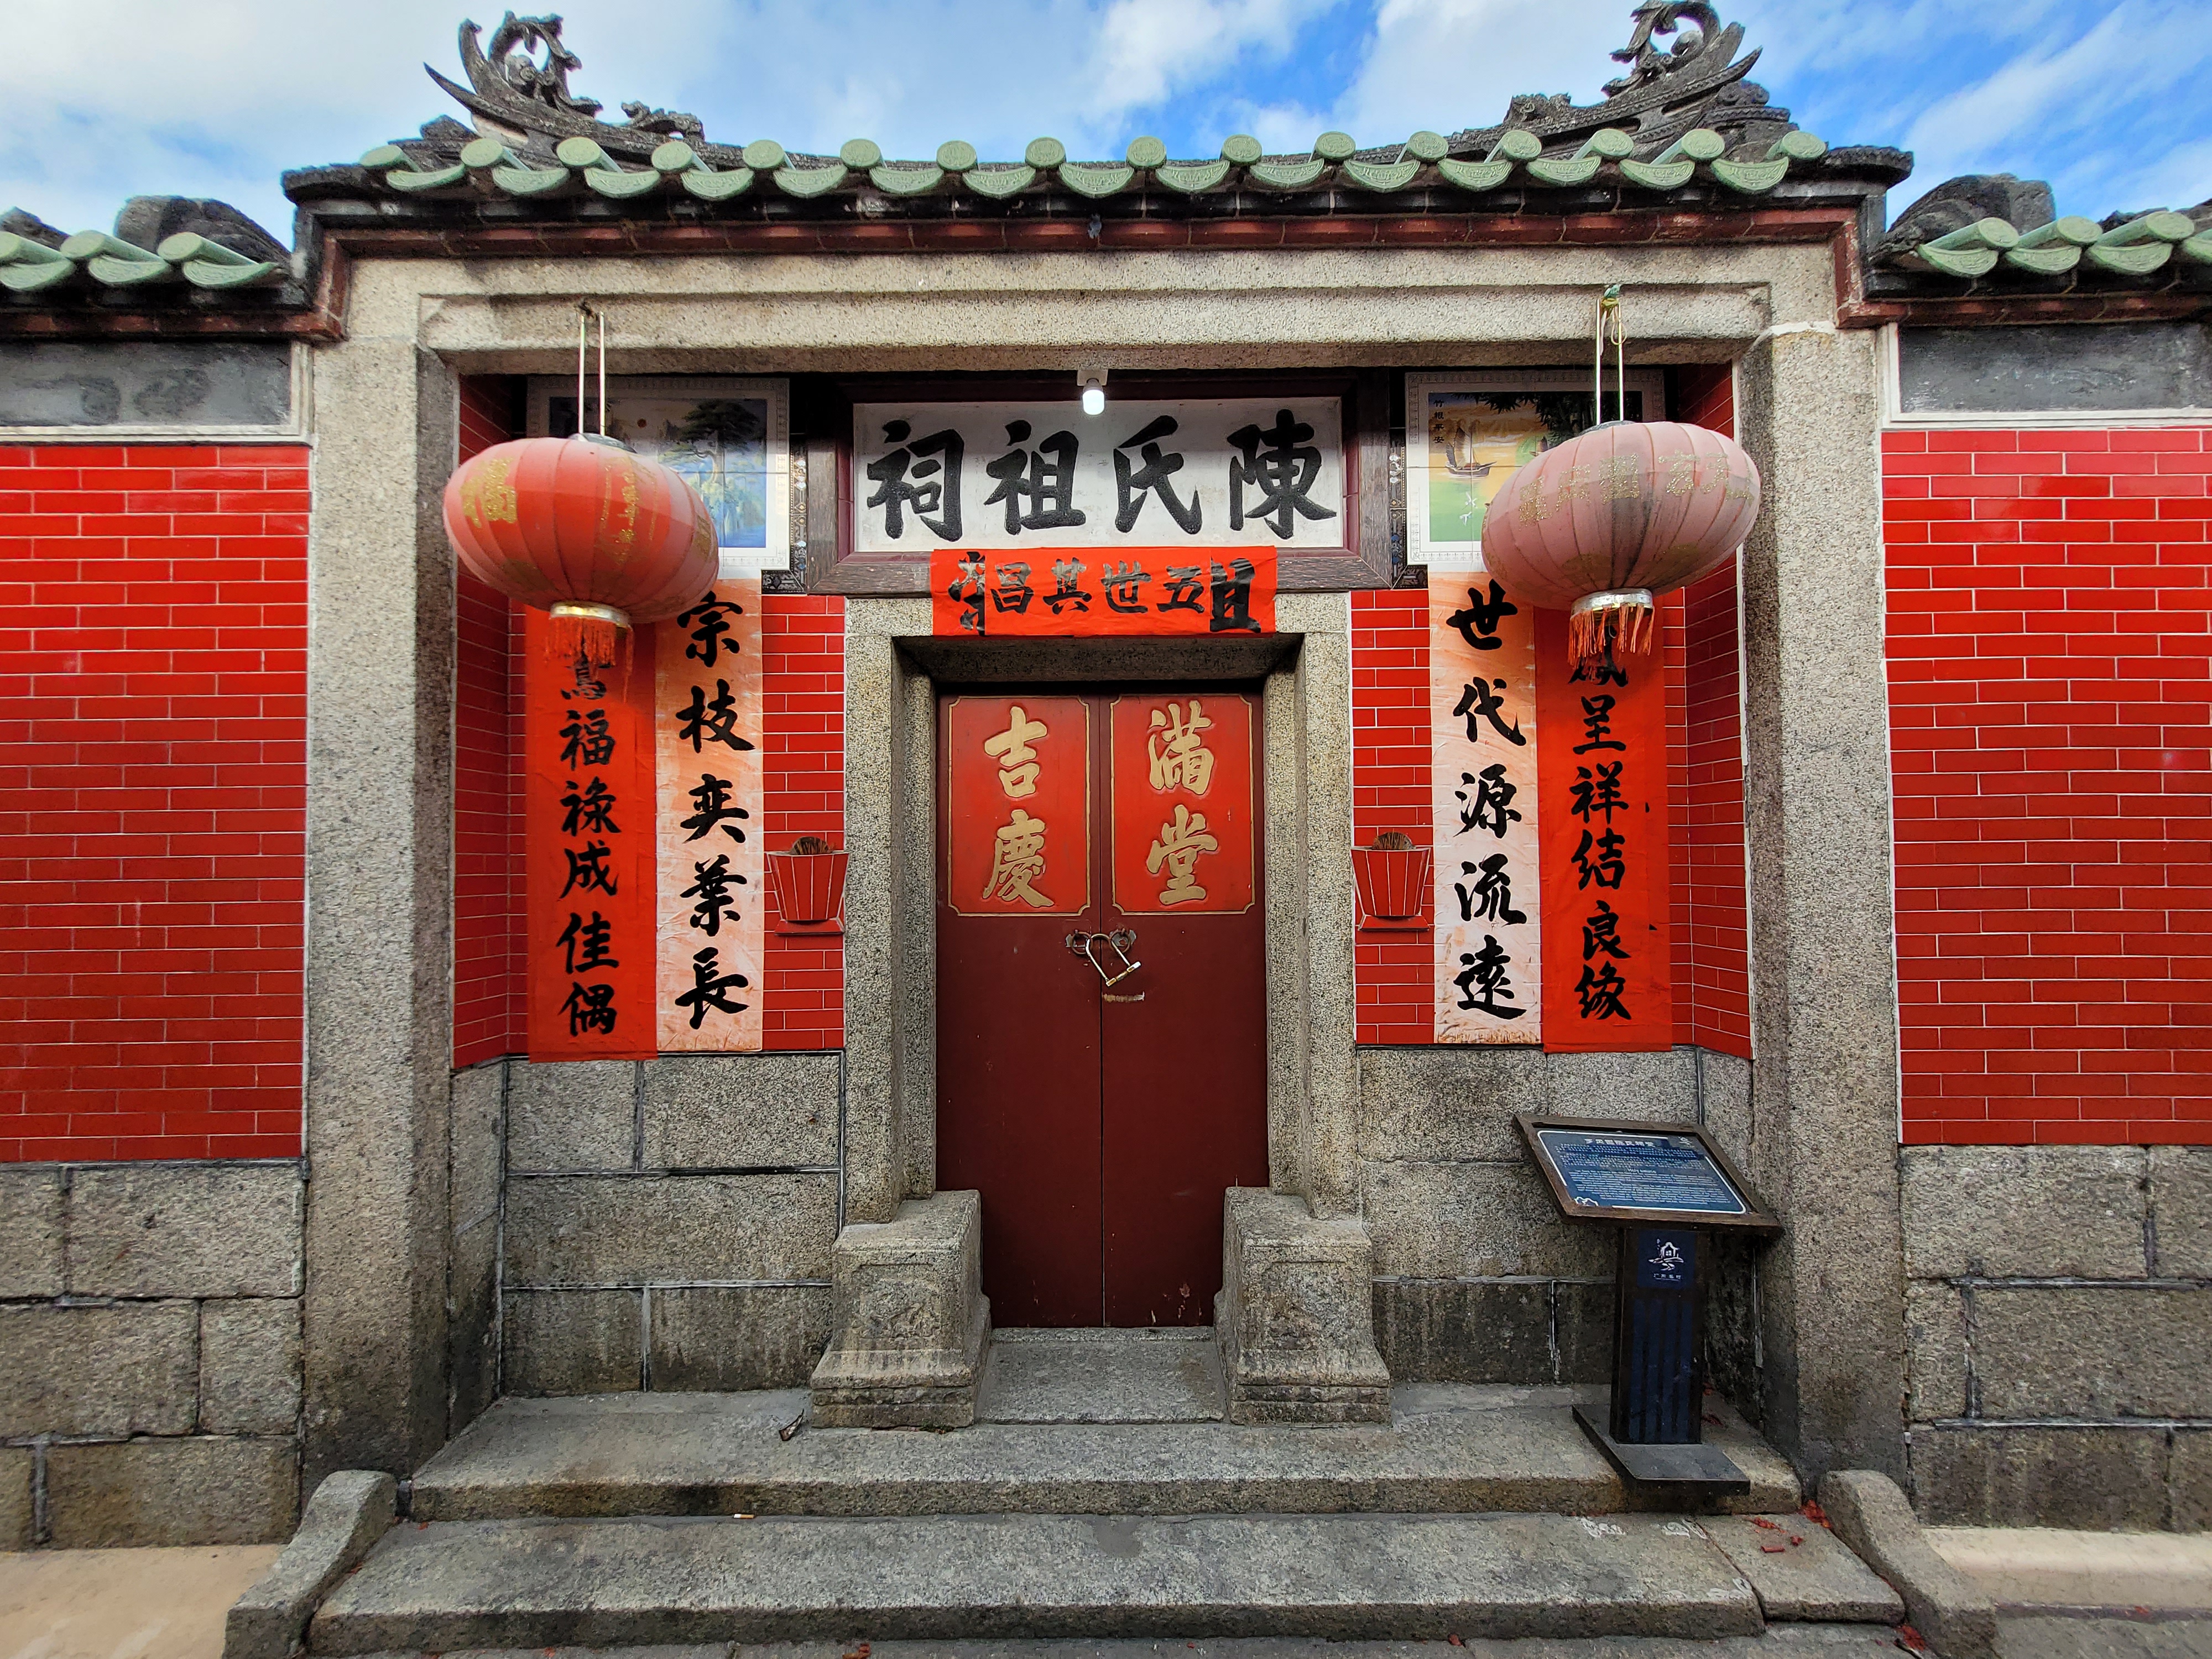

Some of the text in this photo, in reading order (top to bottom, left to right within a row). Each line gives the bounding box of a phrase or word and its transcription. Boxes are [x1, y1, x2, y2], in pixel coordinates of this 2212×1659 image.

[867, 409, 1337, 542] 陳氏祖祠
[675, 591, 755, 1030] 宗枝奕葉長
[1446, 578, 1527, 1020] 世代源流遠
